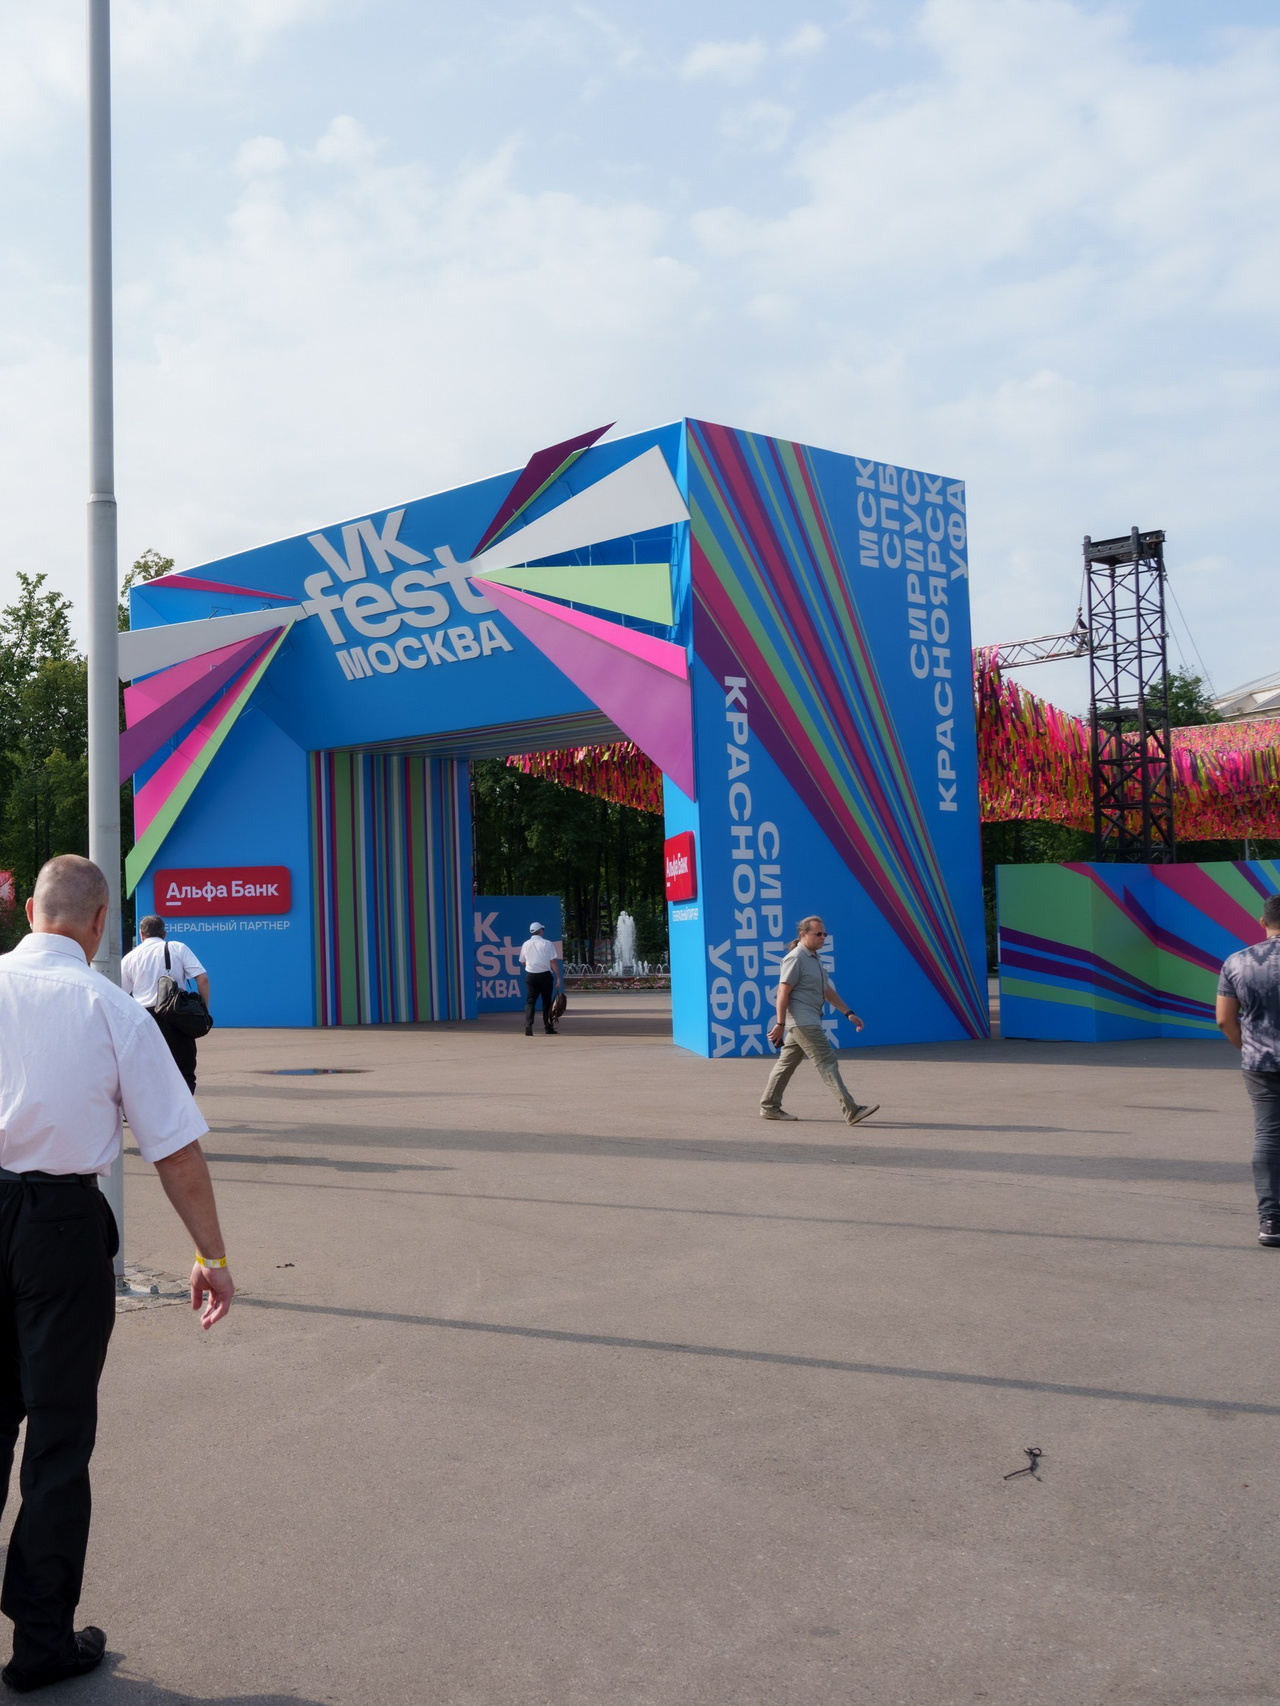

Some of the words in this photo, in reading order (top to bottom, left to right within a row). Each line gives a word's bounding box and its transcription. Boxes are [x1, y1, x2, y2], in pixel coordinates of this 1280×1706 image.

[307, 508, 432, 583] VK
[855, 457, 880, 568] МСК
[878, 465, 902, 569] СПБ
[946, 481, 969, 581] УФА
[298, 545, 498, 645] fest
[901, 469, 930, 680] СИРИУС
[335, 620, 514, 681] МОСКВА
[923, 473, 958, 812] КРАСНОЯРСК
[166, 881, 228, 903] Альфа
[231, 880, 279, 897] Банк
[724, 676, 764, 1056] КРАСНОЯРСК
[164, 920, 237, 932] ЕНЕРАЛЬНЫЙ
[239, 921, 291, 931] ПАРТНЕР
[708, 939, 736, 1058] УФА
